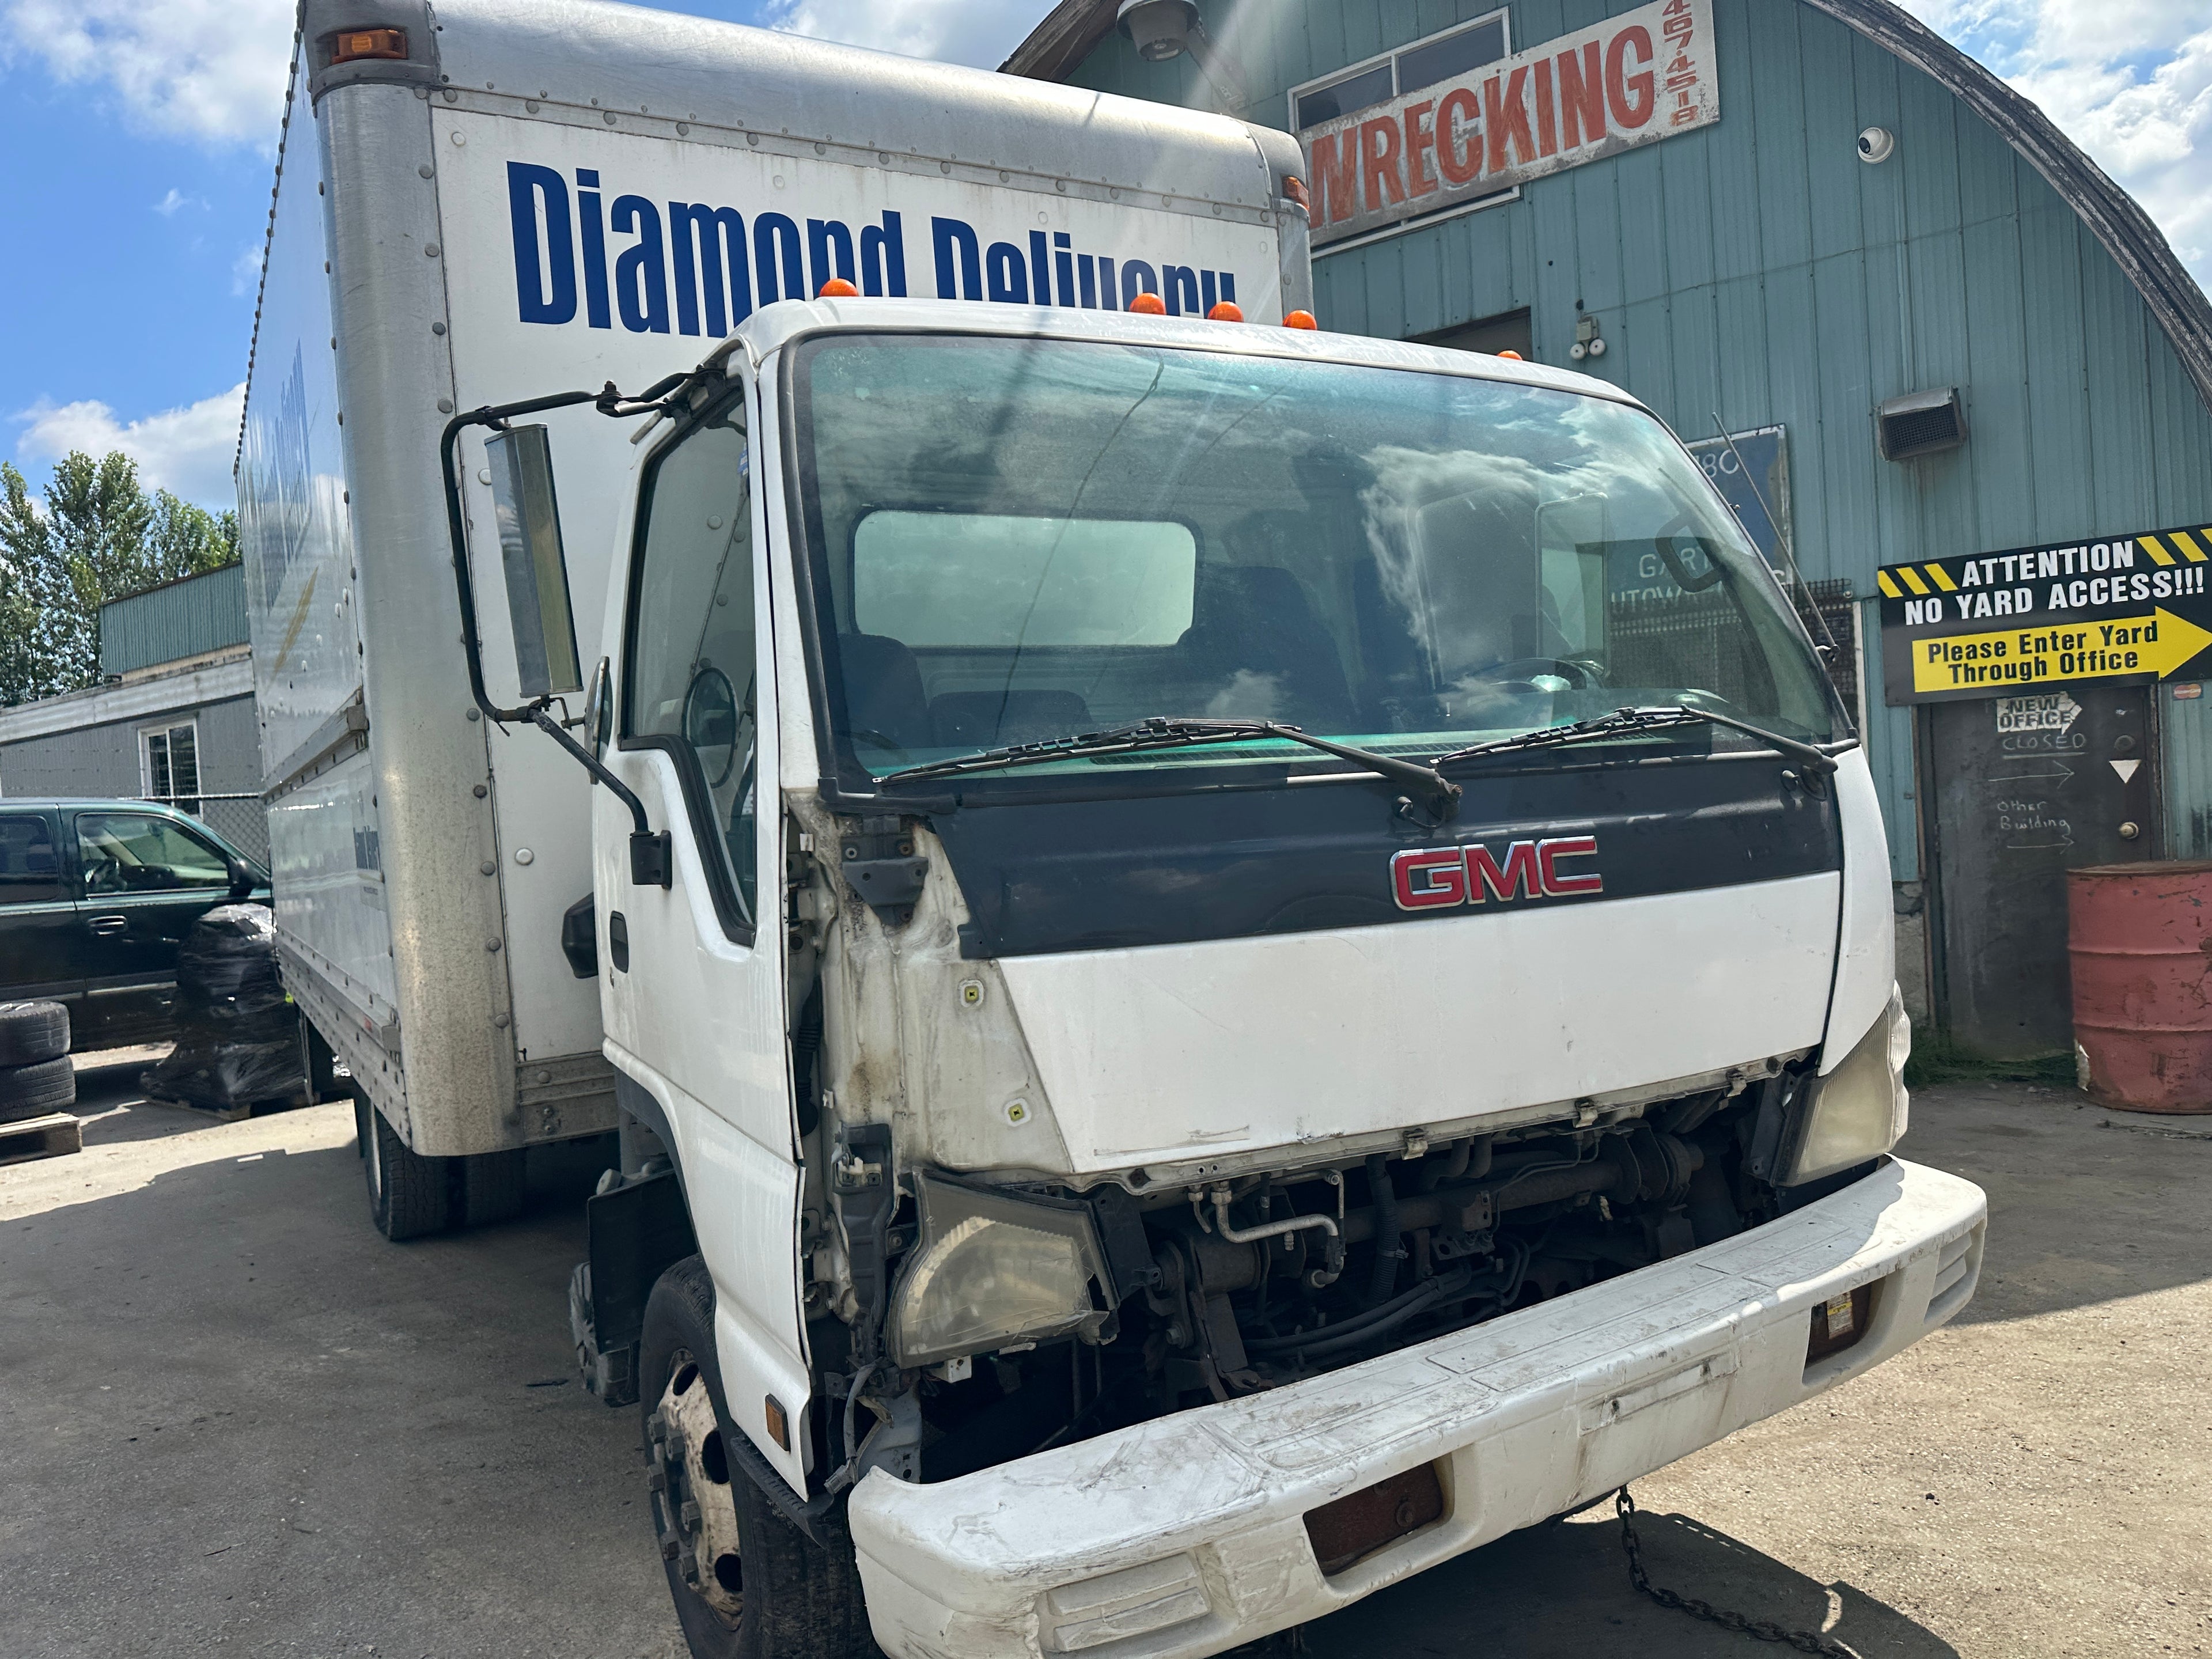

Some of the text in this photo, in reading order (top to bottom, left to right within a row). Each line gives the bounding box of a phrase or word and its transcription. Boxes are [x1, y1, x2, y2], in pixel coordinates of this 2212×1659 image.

[506, 161, 907, 339] Diamond
[1961, 540, 2134, 588] ATTENTION
[1904, 566, 2204, 626] NO YARD ACCESS!!!
[1927, 621, 2158, 663] Please Enter Yard
[1948, 650, 2138, 681] Through Office
[1999, 711, 2072, 729] OFFICE
[2007, 696, 2059, 714] NEW
[2002, 733, 2086, 751] CLOSED
[2000, 815, 2071, 835] Building
[1389, 835, 1604, 911] GMC
